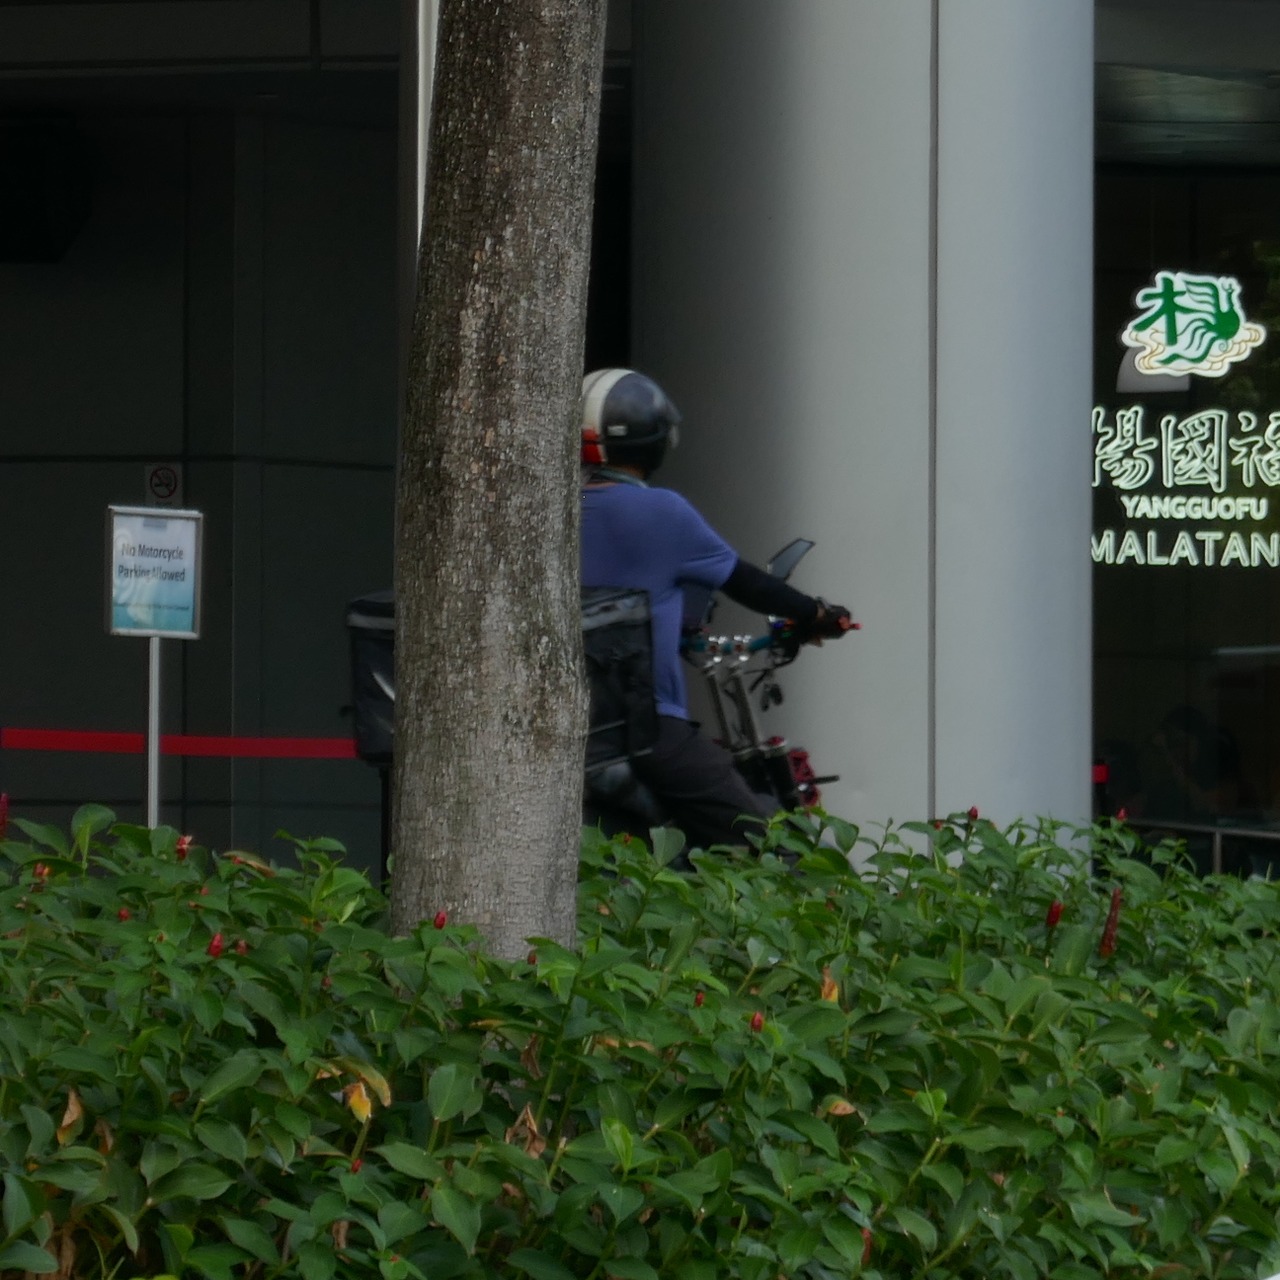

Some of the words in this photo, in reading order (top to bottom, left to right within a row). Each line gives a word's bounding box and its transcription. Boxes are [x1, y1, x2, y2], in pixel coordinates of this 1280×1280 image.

[1120, 495, 1268, 520] YANGGUOFU
[121, 543, 136, 556] No
[138, 543, 184, 562] Motorcycle
